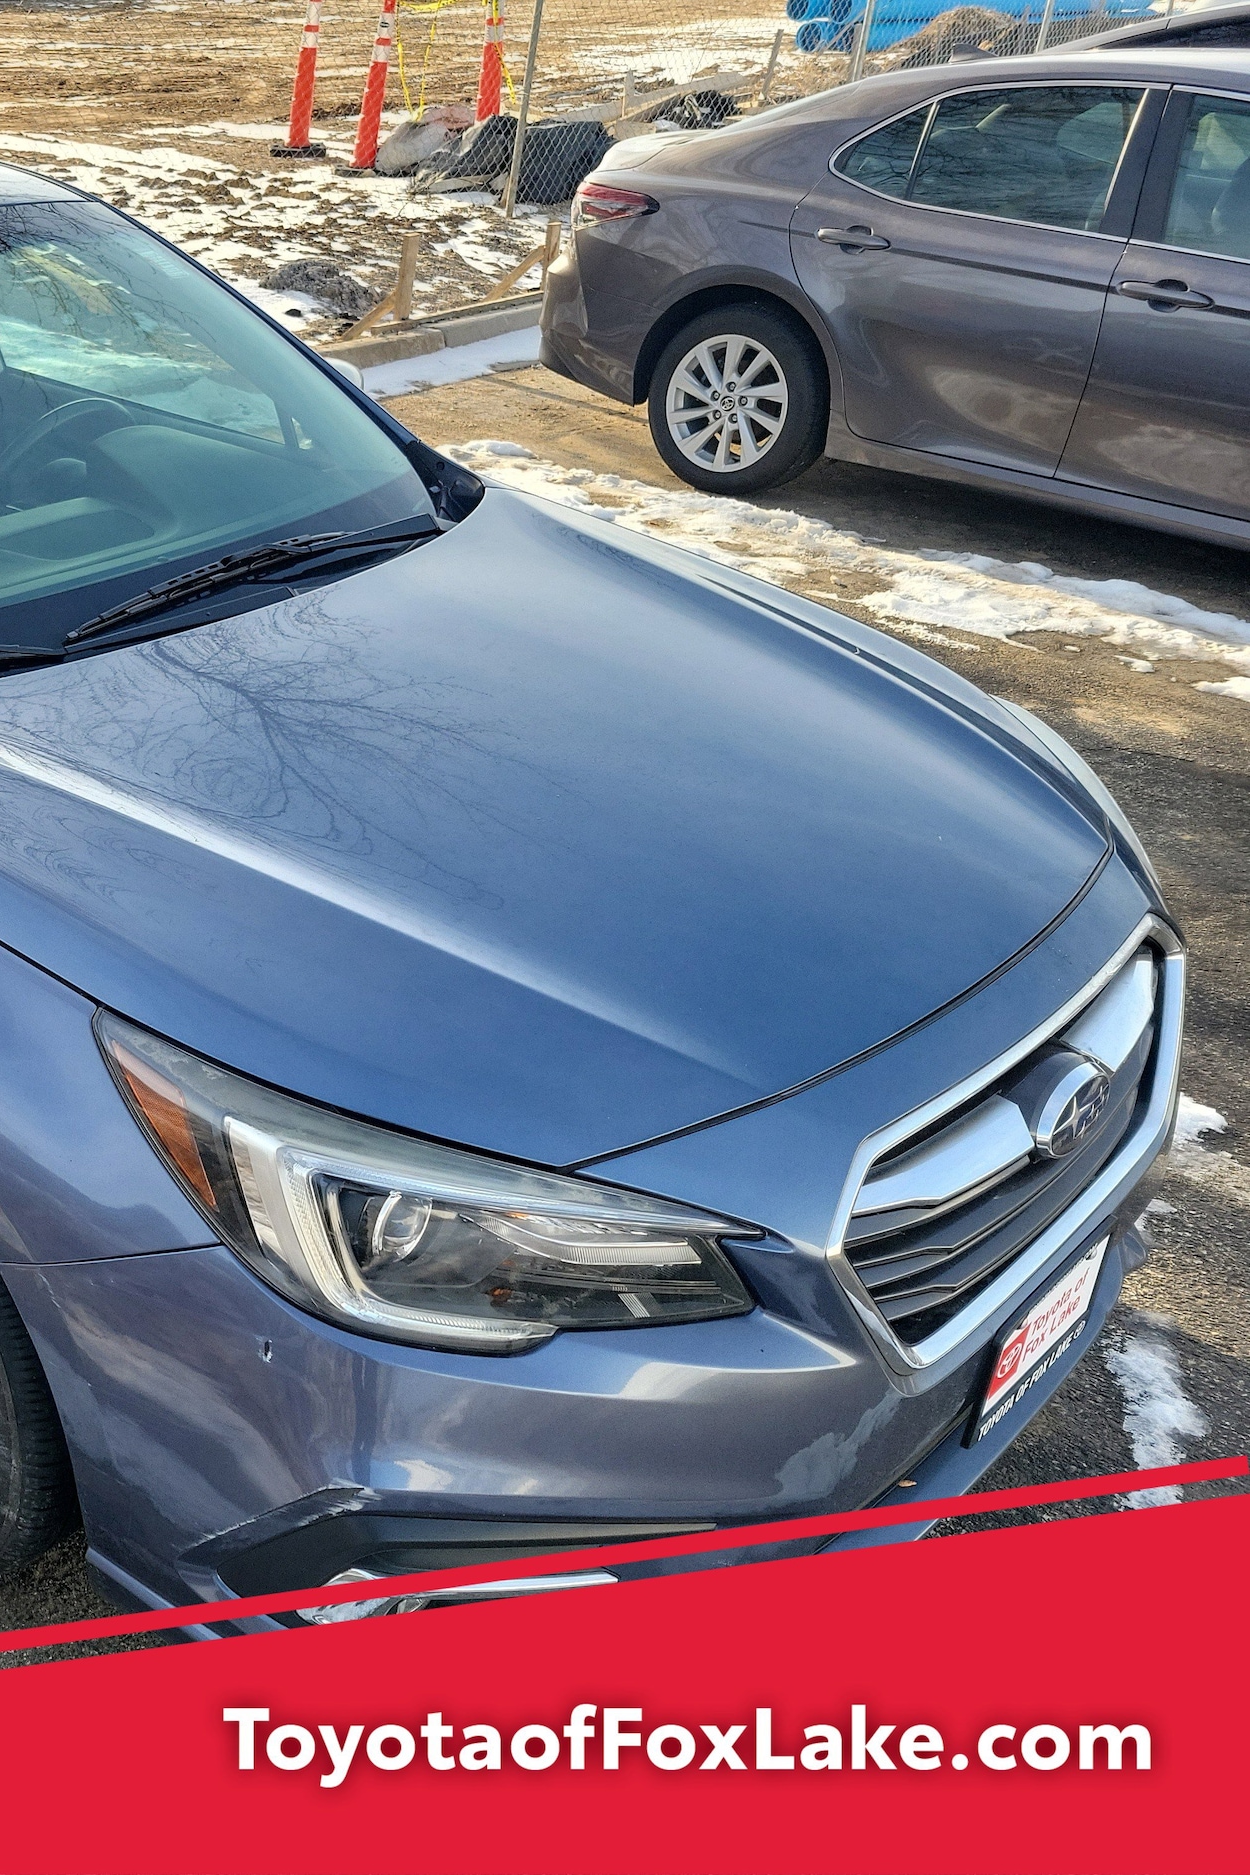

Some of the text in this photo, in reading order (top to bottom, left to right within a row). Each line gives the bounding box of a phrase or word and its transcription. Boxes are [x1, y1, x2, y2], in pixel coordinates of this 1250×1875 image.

[1021, 1296, 1081, 1362] Fox Lake
[1031, 1291, 1071, 1335] Toyota
[1074, 1267, 1090, 1293] of
[978, 1332, 1074, 1441] TOYOTA OF FOX LAKE
